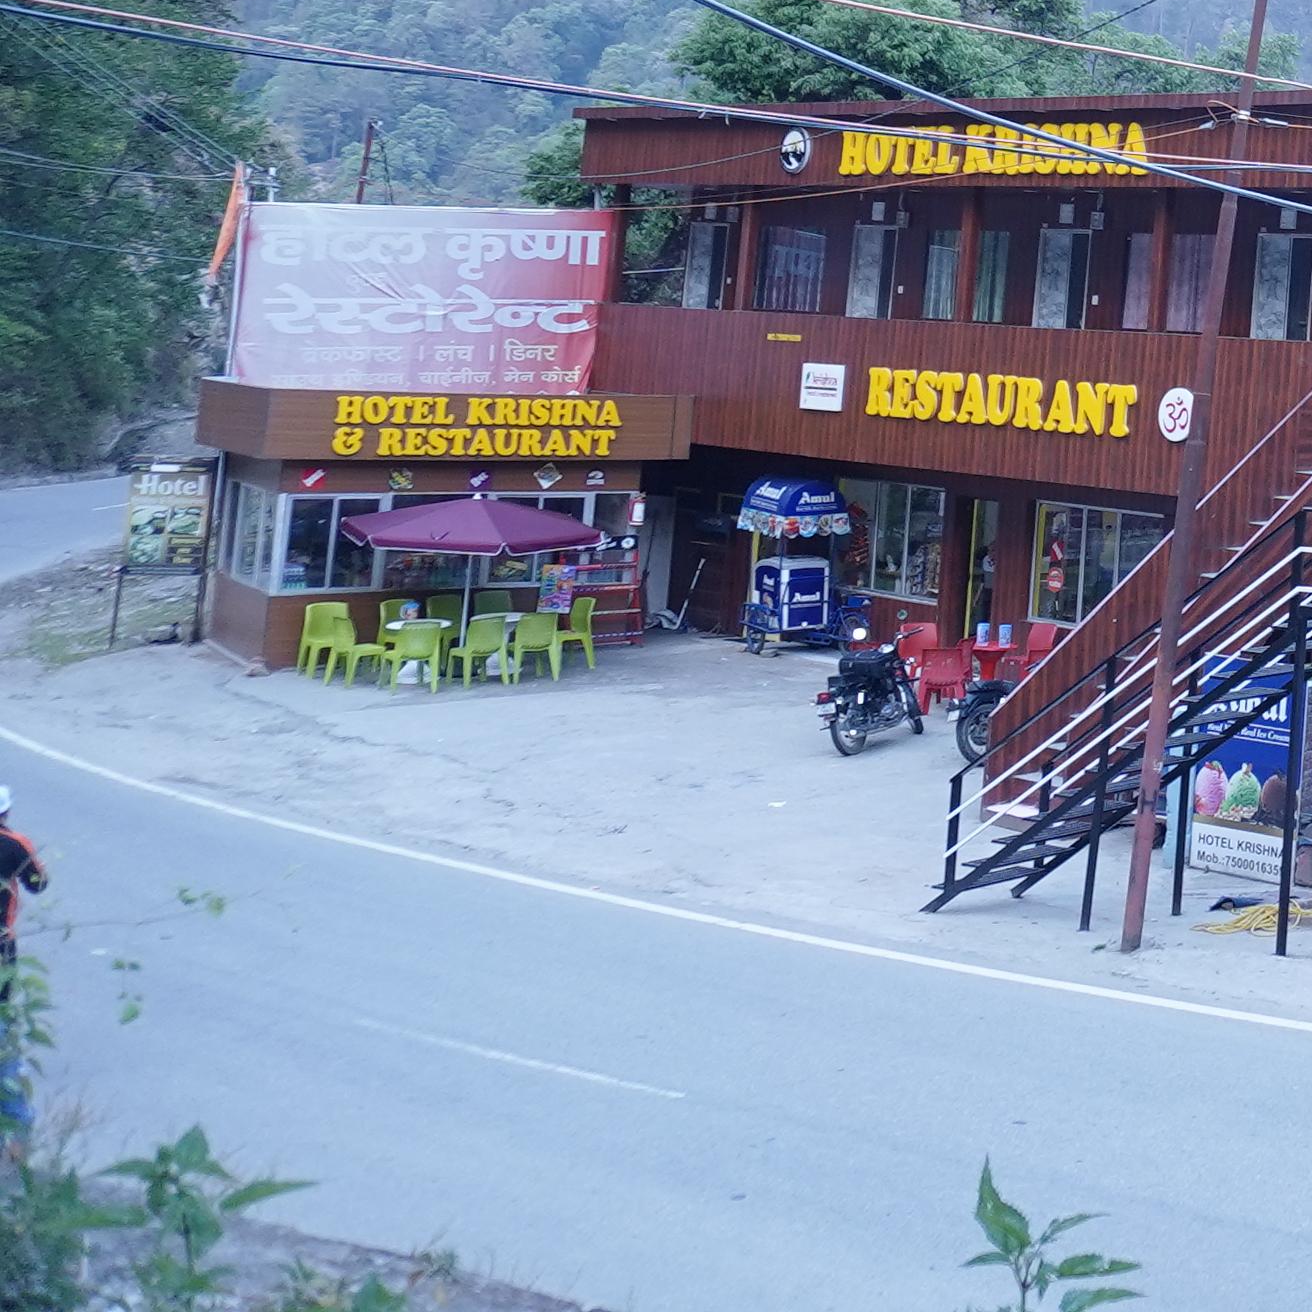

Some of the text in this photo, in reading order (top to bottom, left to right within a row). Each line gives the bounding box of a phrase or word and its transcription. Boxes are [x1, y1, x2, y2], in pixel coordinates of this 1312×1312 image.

[839, 126, 959, 176] HOTEL
[445, 229, 605, 280] कृष्णा
[434, 339, 475, 362] लंच
[504, 339, 559, 361] डिनर
[504, 367, 536, 383] मेन
[541, 366, 583, 383] कोर्स
[334, 396, 623, 427] HOTEL KRISHNA
[865, 367, 1137, 438] RESTAURANT
[332, 427, 617, 457] & RESTAURANT
[133, 474, 208, 496] Hotel
[799, 492, 835, 504] Amul
[1198, 832, 1233, 850] HOTEL
[1196, 850, 1281, 876] Mob.:750001635
